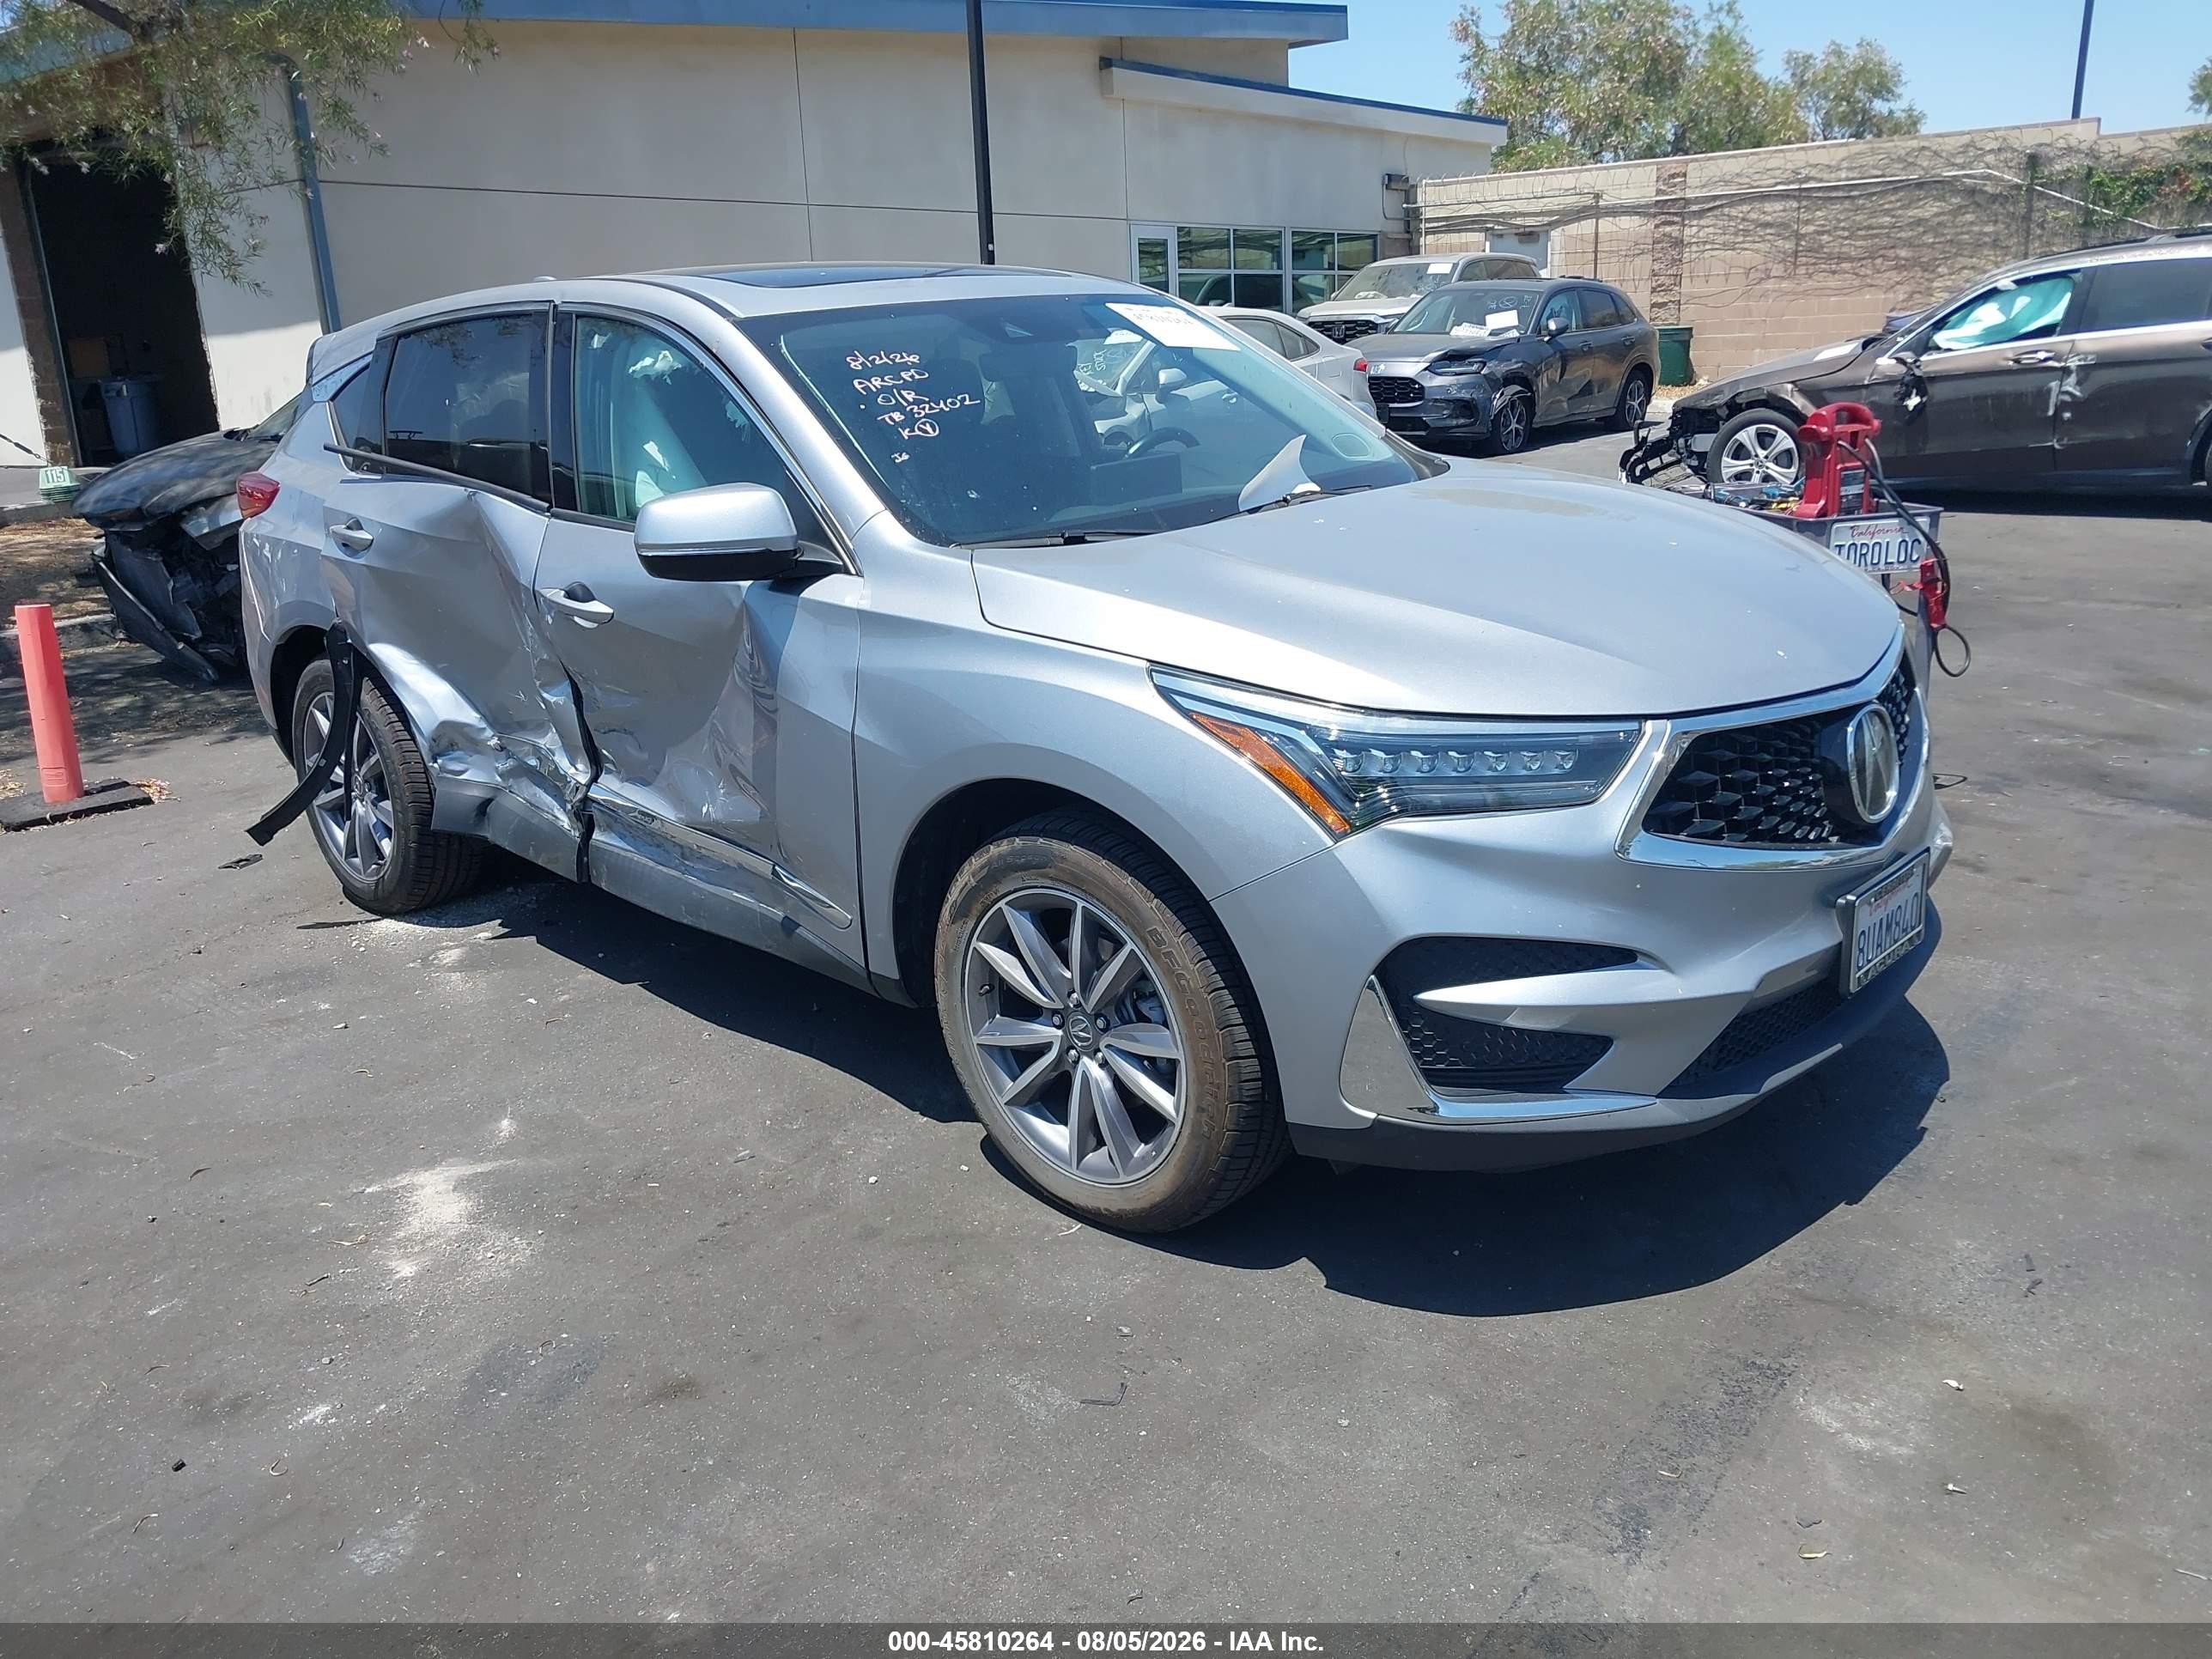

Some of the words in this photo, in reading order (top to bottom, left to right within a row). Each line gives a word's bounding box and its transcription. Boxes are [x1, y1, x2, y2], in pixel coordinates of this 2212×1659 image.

[45, 469, 65, 483] 115
[1850, 524, 1910, 540] California
[1856, 891, 1920, 971] 8UAM840
[1867, 941, 1911, 980] ACURA
[1146, 927, 1218, 1139] BFGoodrich
